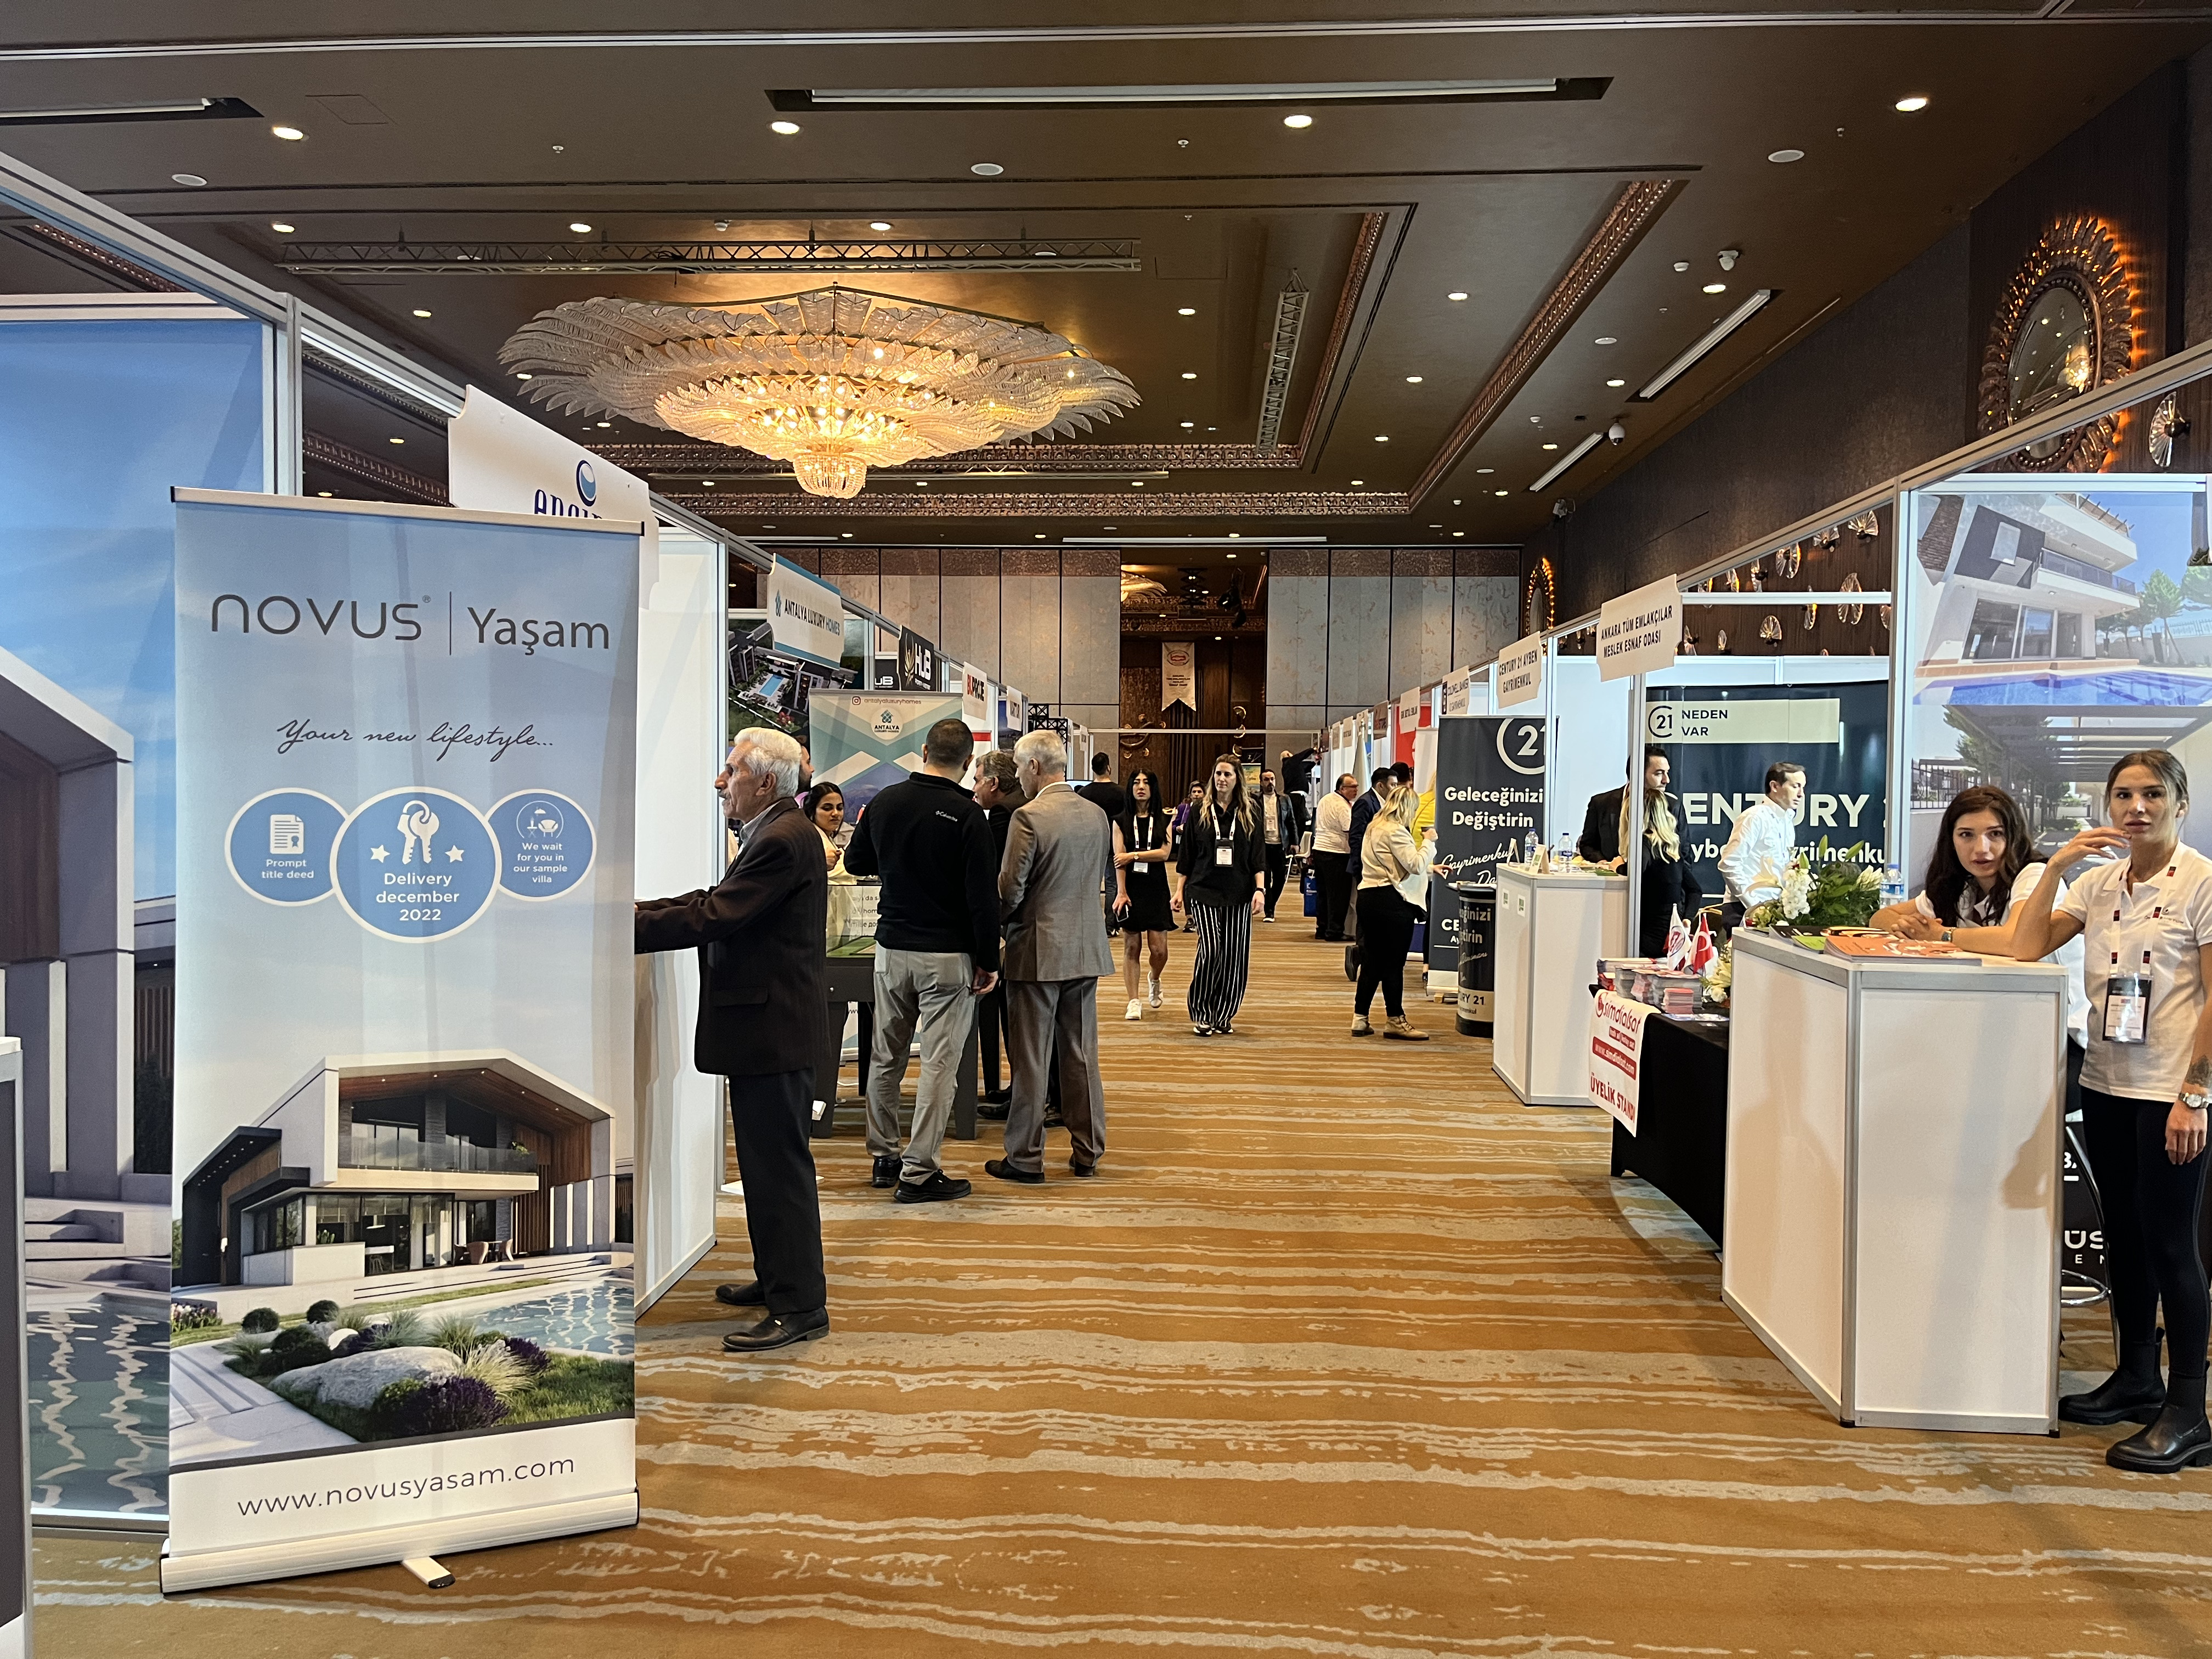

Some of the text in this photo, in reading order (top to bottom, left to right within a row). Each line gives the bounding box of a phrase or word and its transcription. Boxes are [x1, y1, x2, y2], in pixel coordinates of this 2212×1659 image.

[785, 599, 807, 622] ANTALYA
[808, 608, 826, 629] LUXURY
[467, 607, 610, 655] Yaşam
[1601, 605, 1672, 641] ANKARA TÜM EMLAKÇILAR
[1604, 629, 1661, 658] MESLEK ESNAF ODASI
[1499, 658, 1517, 676] CENTURY
[1523, 648, 1538, 667] AYBEN
[1657, 710, 1728, 729] 21 NEDEN
[276, 719, 353, 754] Your
[363, 732, 416, 743] new
[1681, 726, 1708, 736] VAR
[1444, 786, 1544, 807] Geleceğinizi
[1452, 811, 1534, 831] Değiştirin
[540, 843, 562, 851] wait
[266, 859, 307, 870] Prompt
[532, 855, 547, 864] you
[287, 870, 314, 879] deed
[533, 864, 567, 874] sample
[384, 872, 452, 887] Delivery
[532, 875, 552, 883] villa
[376, 890, 459, 904] december
[399, 909, 442, 921] 2022
[1473, 995, 1485, 1005] 21
[1591, 1071, 1635, 1123] ÜYELİK STANDI
[238, 1455, 574, 1516] www.novusyasam.com
